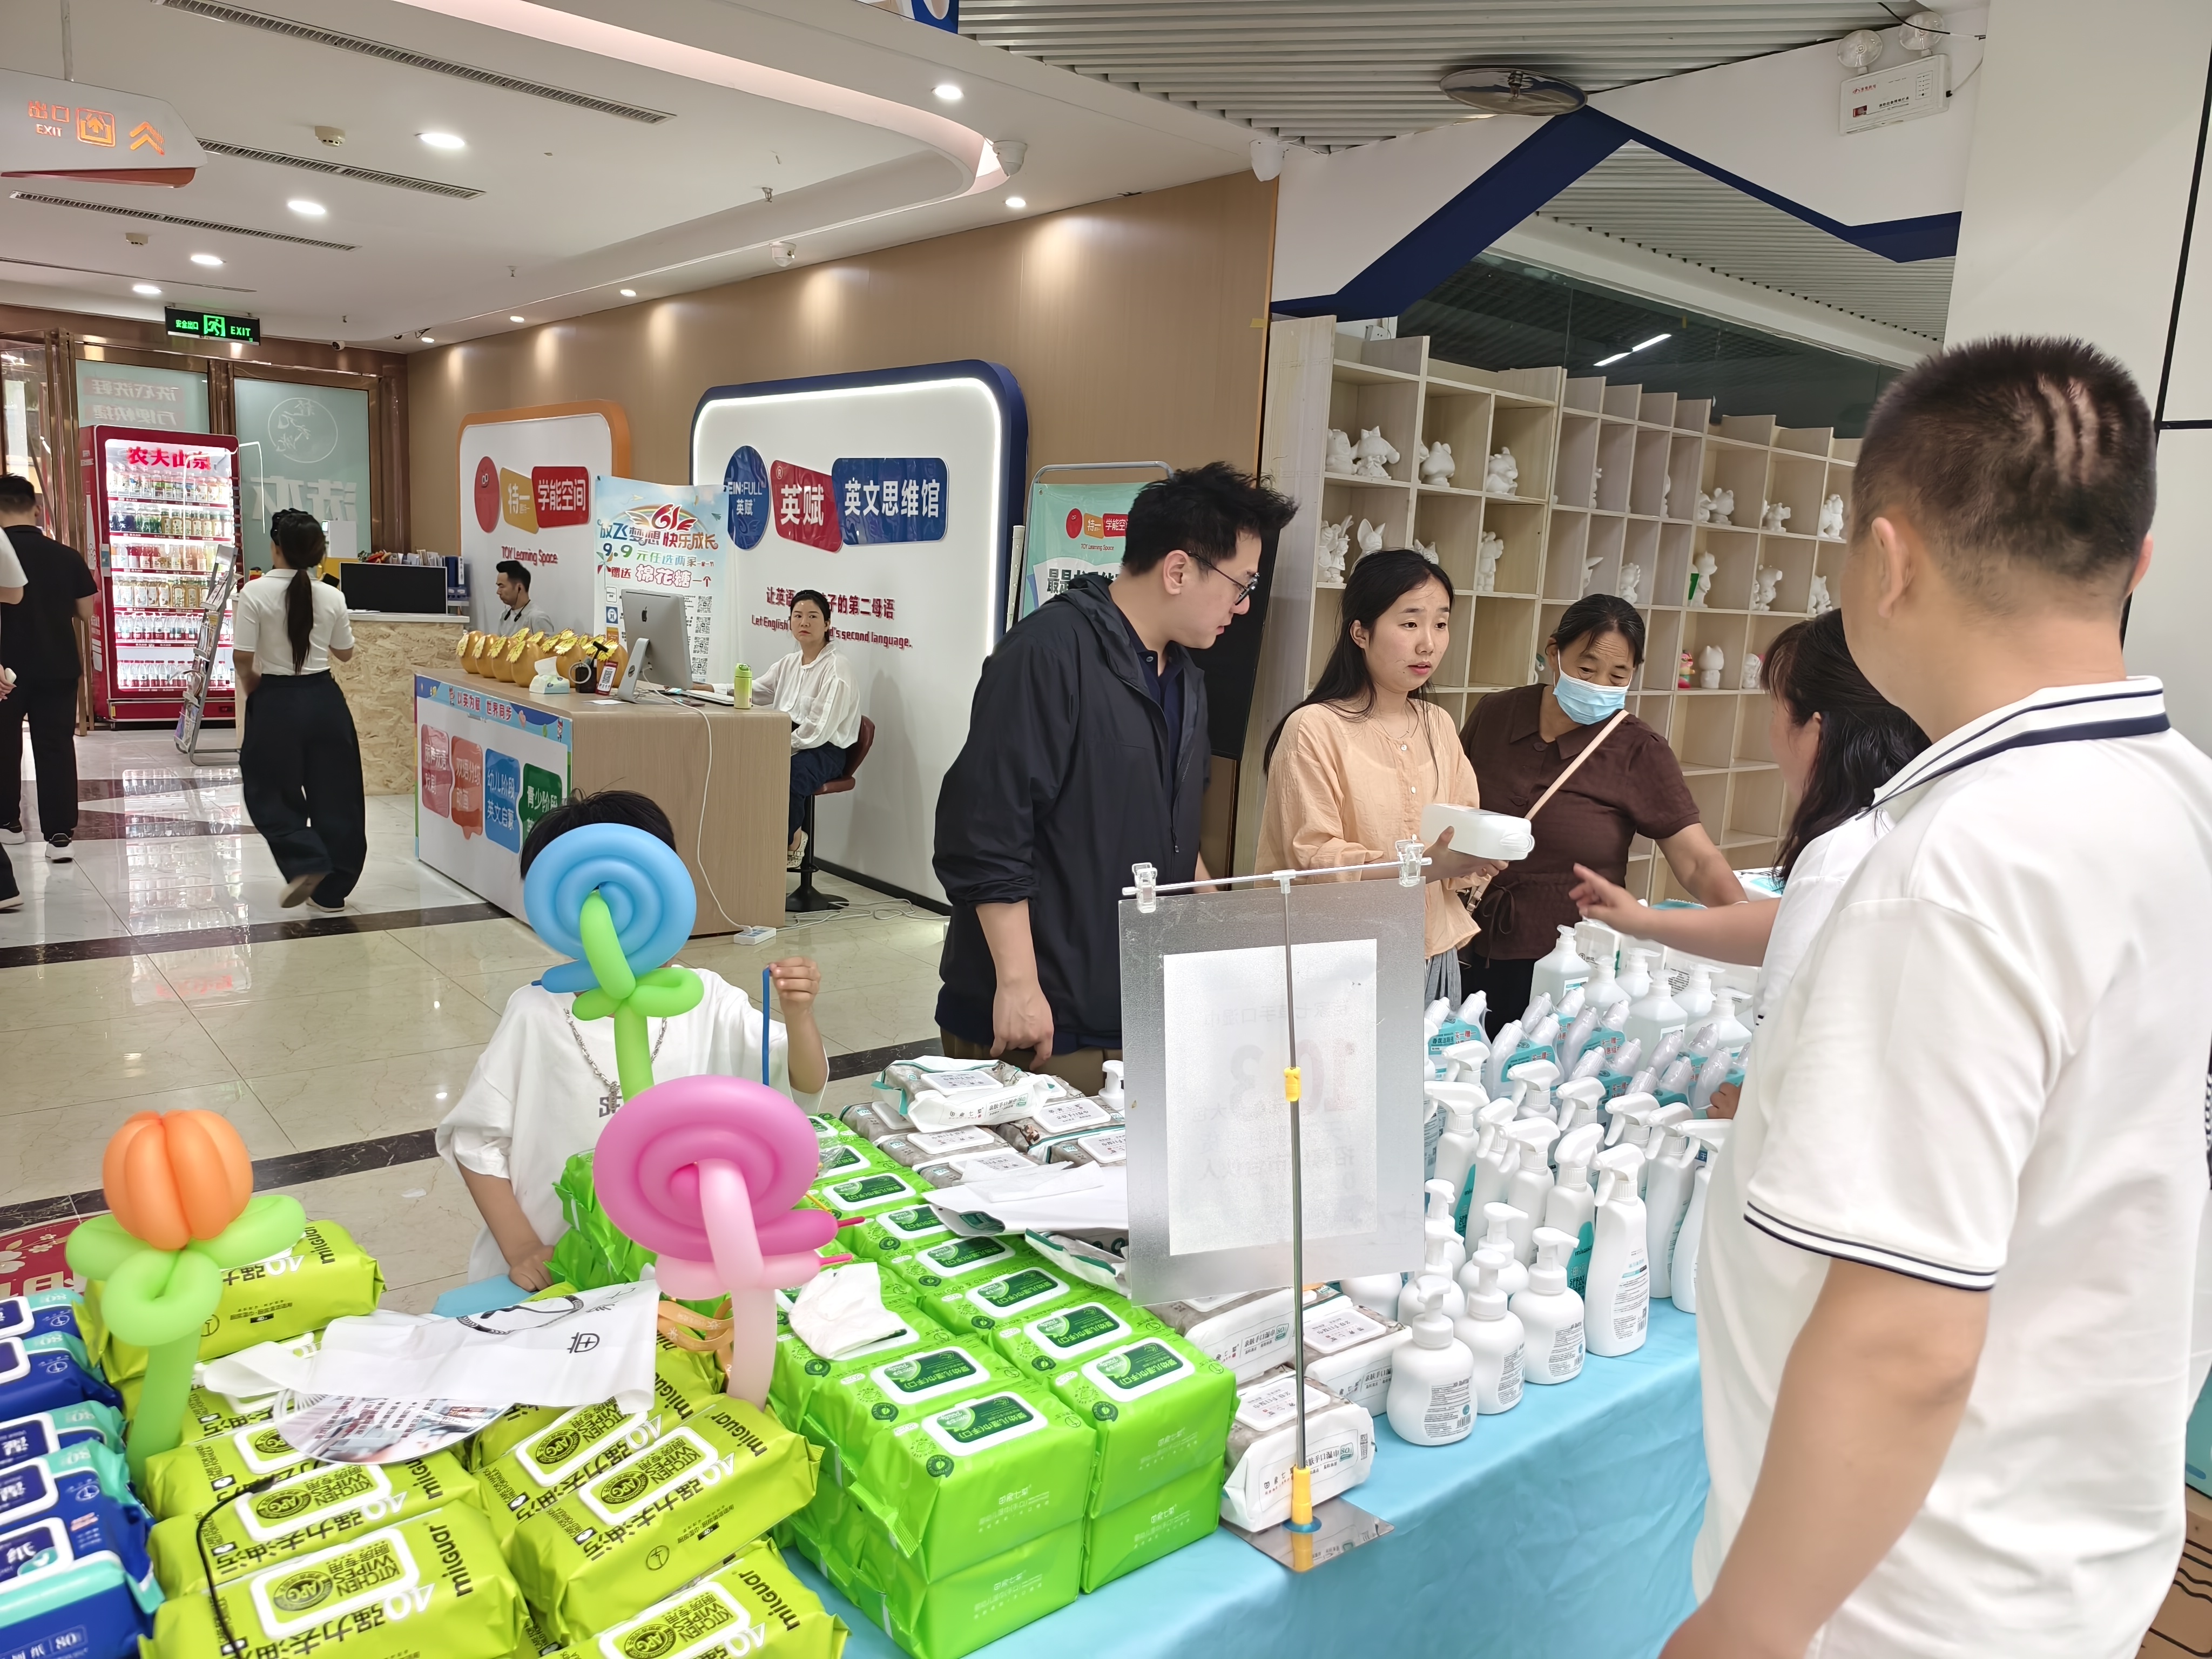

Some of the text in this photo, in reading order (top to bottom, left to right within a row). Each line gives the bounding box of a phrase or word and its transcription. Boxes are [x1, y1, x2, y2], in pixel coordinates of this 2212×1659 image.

[28, 100, 70, 123] 出口
[36, 124, 63, 137] EXIT
[176, 319, 199, 330] 安全出口
[230, 326, 251, 336] EXIT
[537, 478, 586, 511] 学能空间
[736, 498, 753, 516] 英赋
[780, 478, 940, 526] 英赋 英文思维馆
[597, 519, 719, 550] 放飞梦想 快乐成长
[514, 547, 537, 566] Learning
[538, 549, 558, 566] Space
[603, 543, 633, 558] 9.9
[635, 563, 692, 588] 棉花糖
[751, 615, 763, 627] Let
[763, 617, 788, 631] English
[841, 630, 869, 643] second
[487, 768, 515, 800] 幼儿阶段
[545, 1435, 569, 1457] APG
[624, 1413, 662, 1451] 40
[644, 1444, 694, 1476] WIPES
[649, 1449, 701, 1485] KITCHEN
[310, 1473, 368, 1497] WIPES
[313, 1477, 374, 1507] KITCHEN
[610, 1478, 637, 1498] APG
[268, 1495, 297, 1513] APG
[582, 1478, 704, 1562] 强力去油污
[332, 1554, 395, 1583] WIPES
[336, 1563, 400, 1597] KITCHEN
[286, 1580, 318, 1601] APG
[382, 1582, 436, 1622] 40
[671, 1602, 725, 1633] WIPES
[677, 1608, 733, 1643] KITCHEN
[636, 1631, 663, 1652] APG
